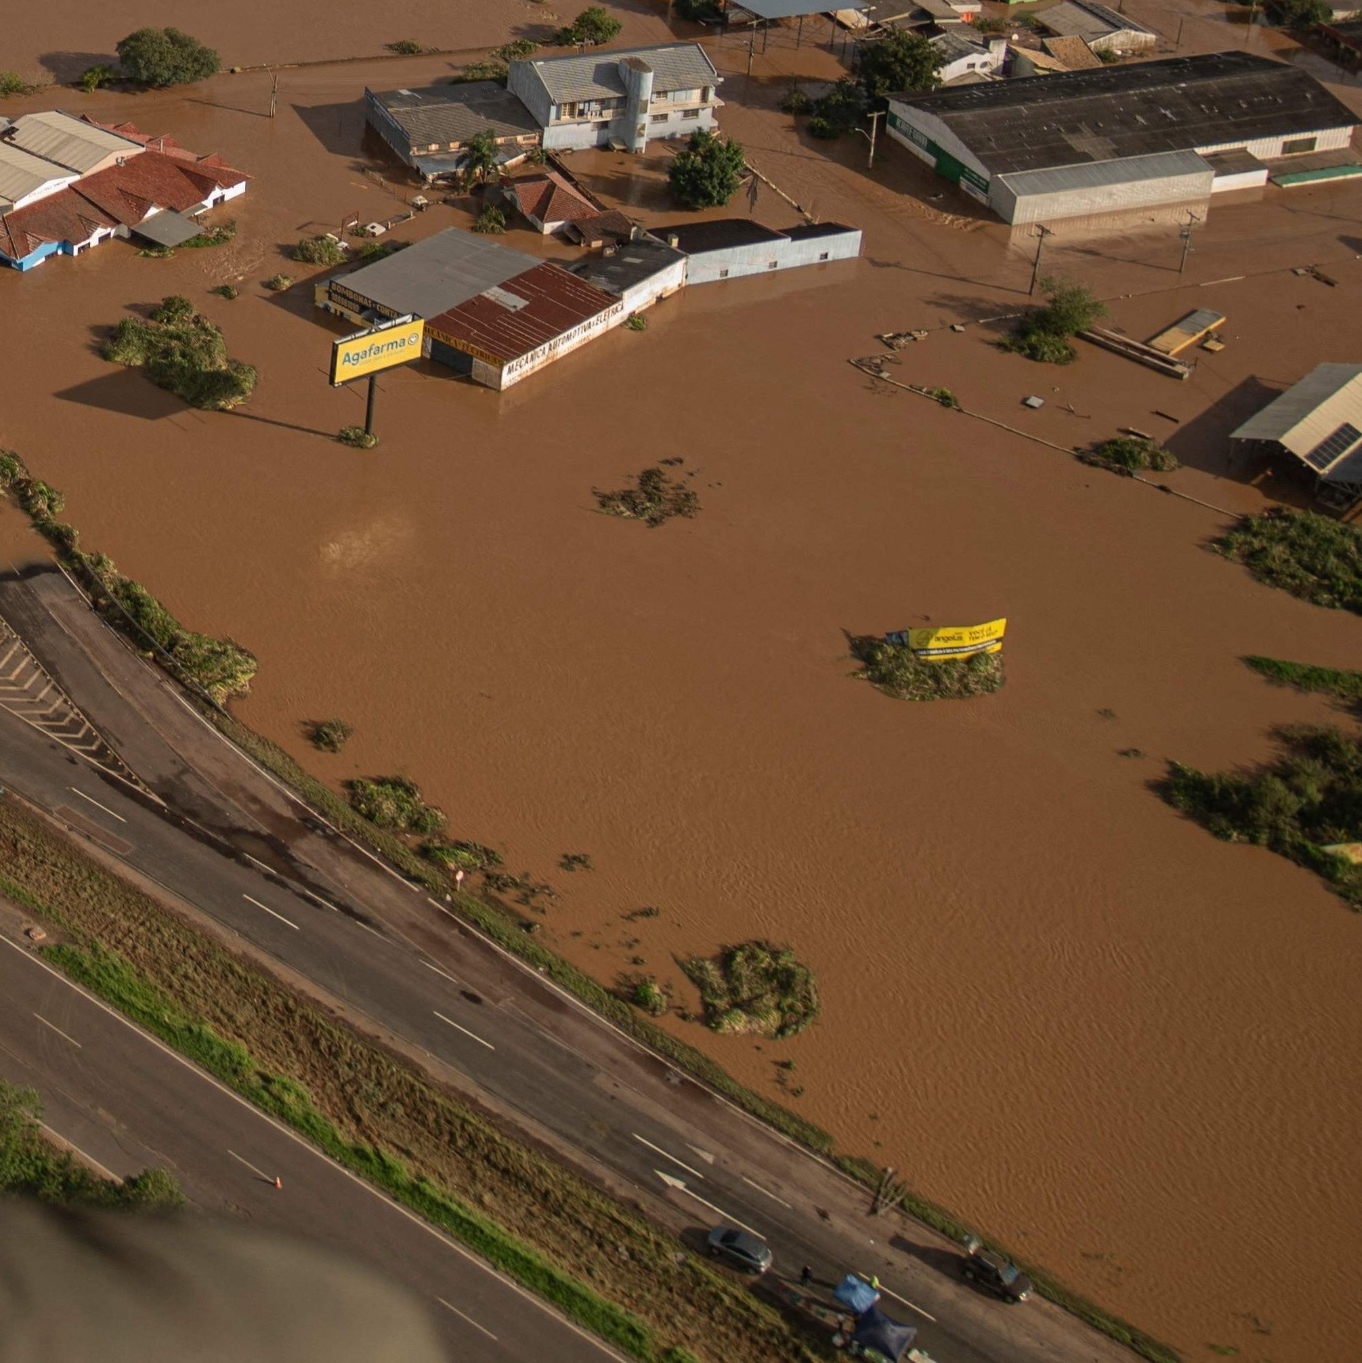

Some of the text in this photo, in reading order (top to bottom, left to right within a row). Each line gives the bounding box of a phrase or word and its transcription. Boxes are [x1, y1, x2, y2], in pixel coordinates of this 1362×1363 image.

[331, 282, 373, 308] BOMBONAS
[548, 320, 592, 352] AUTOMOTIVA
[342, 338, 406, 366] Agafarma
